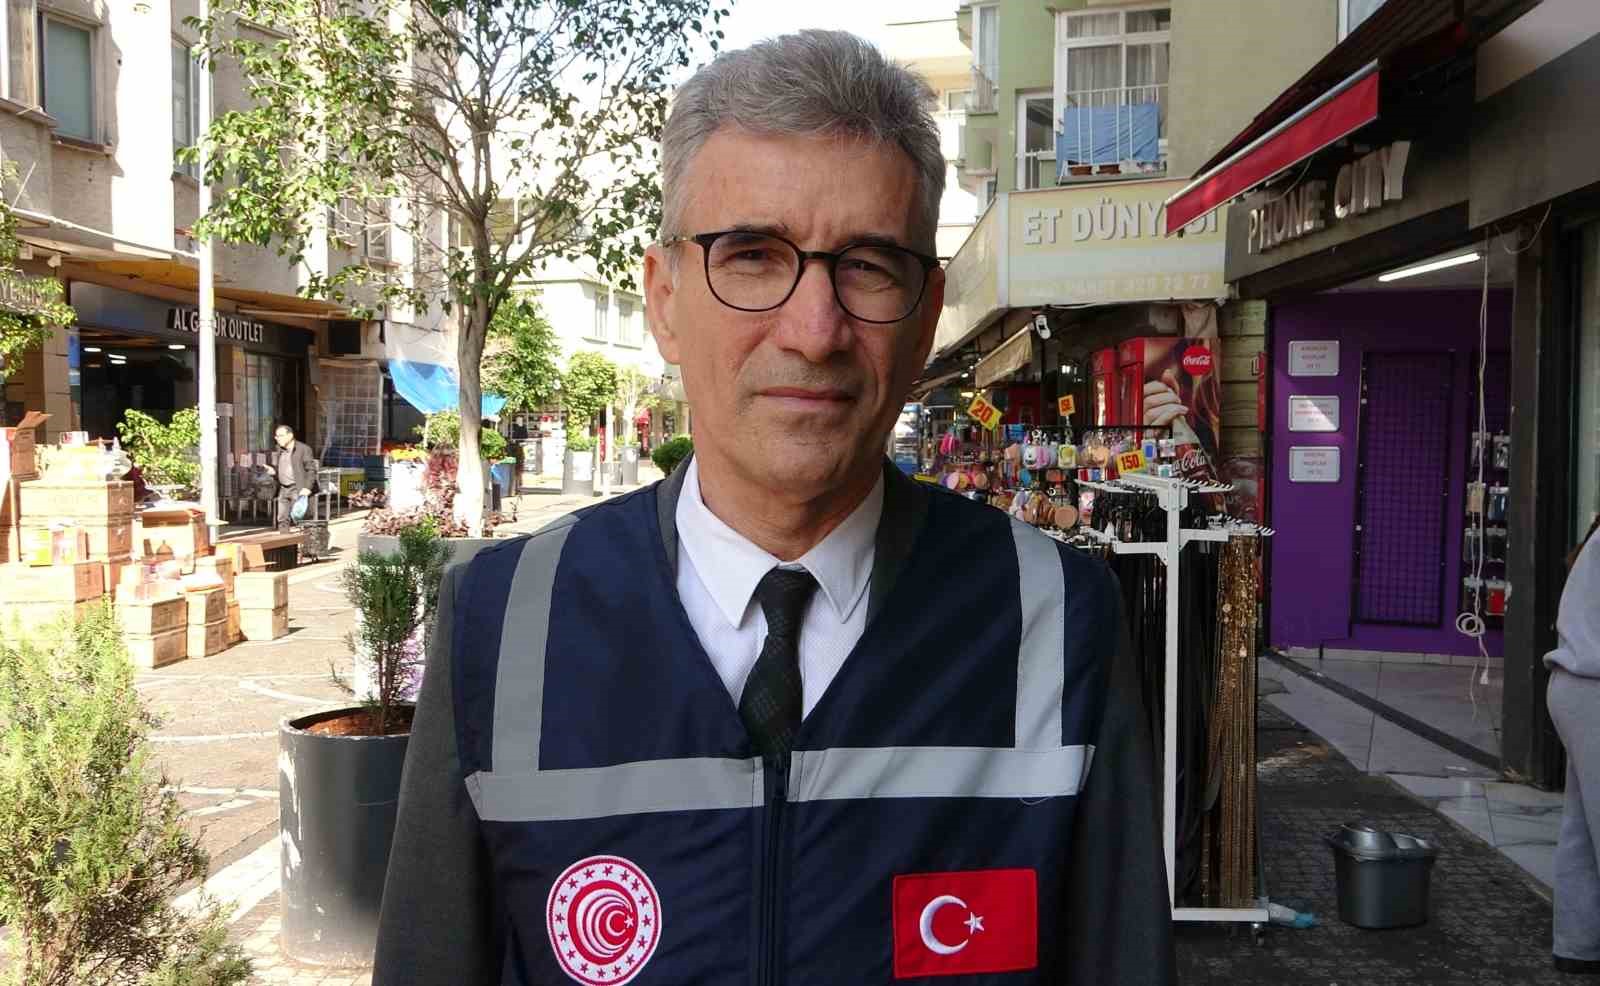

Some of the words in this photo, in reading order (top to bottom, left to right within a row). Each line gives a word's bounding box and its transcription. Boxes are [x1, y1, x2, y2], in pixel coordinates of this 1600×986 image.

[1248, 179, 1326, 254] PHONE
[1334, 140, 1411, 219] CITY
[1024, 207, 1063, 245] ET
[1072, 197, 1219, 241] DÜNYSI
[174, 308, 188, 331] AL
[229, 319, 264, 343] OUTLET
[971, 400, 993, 423] 20
[1120, 453, 1140, 471] 150
